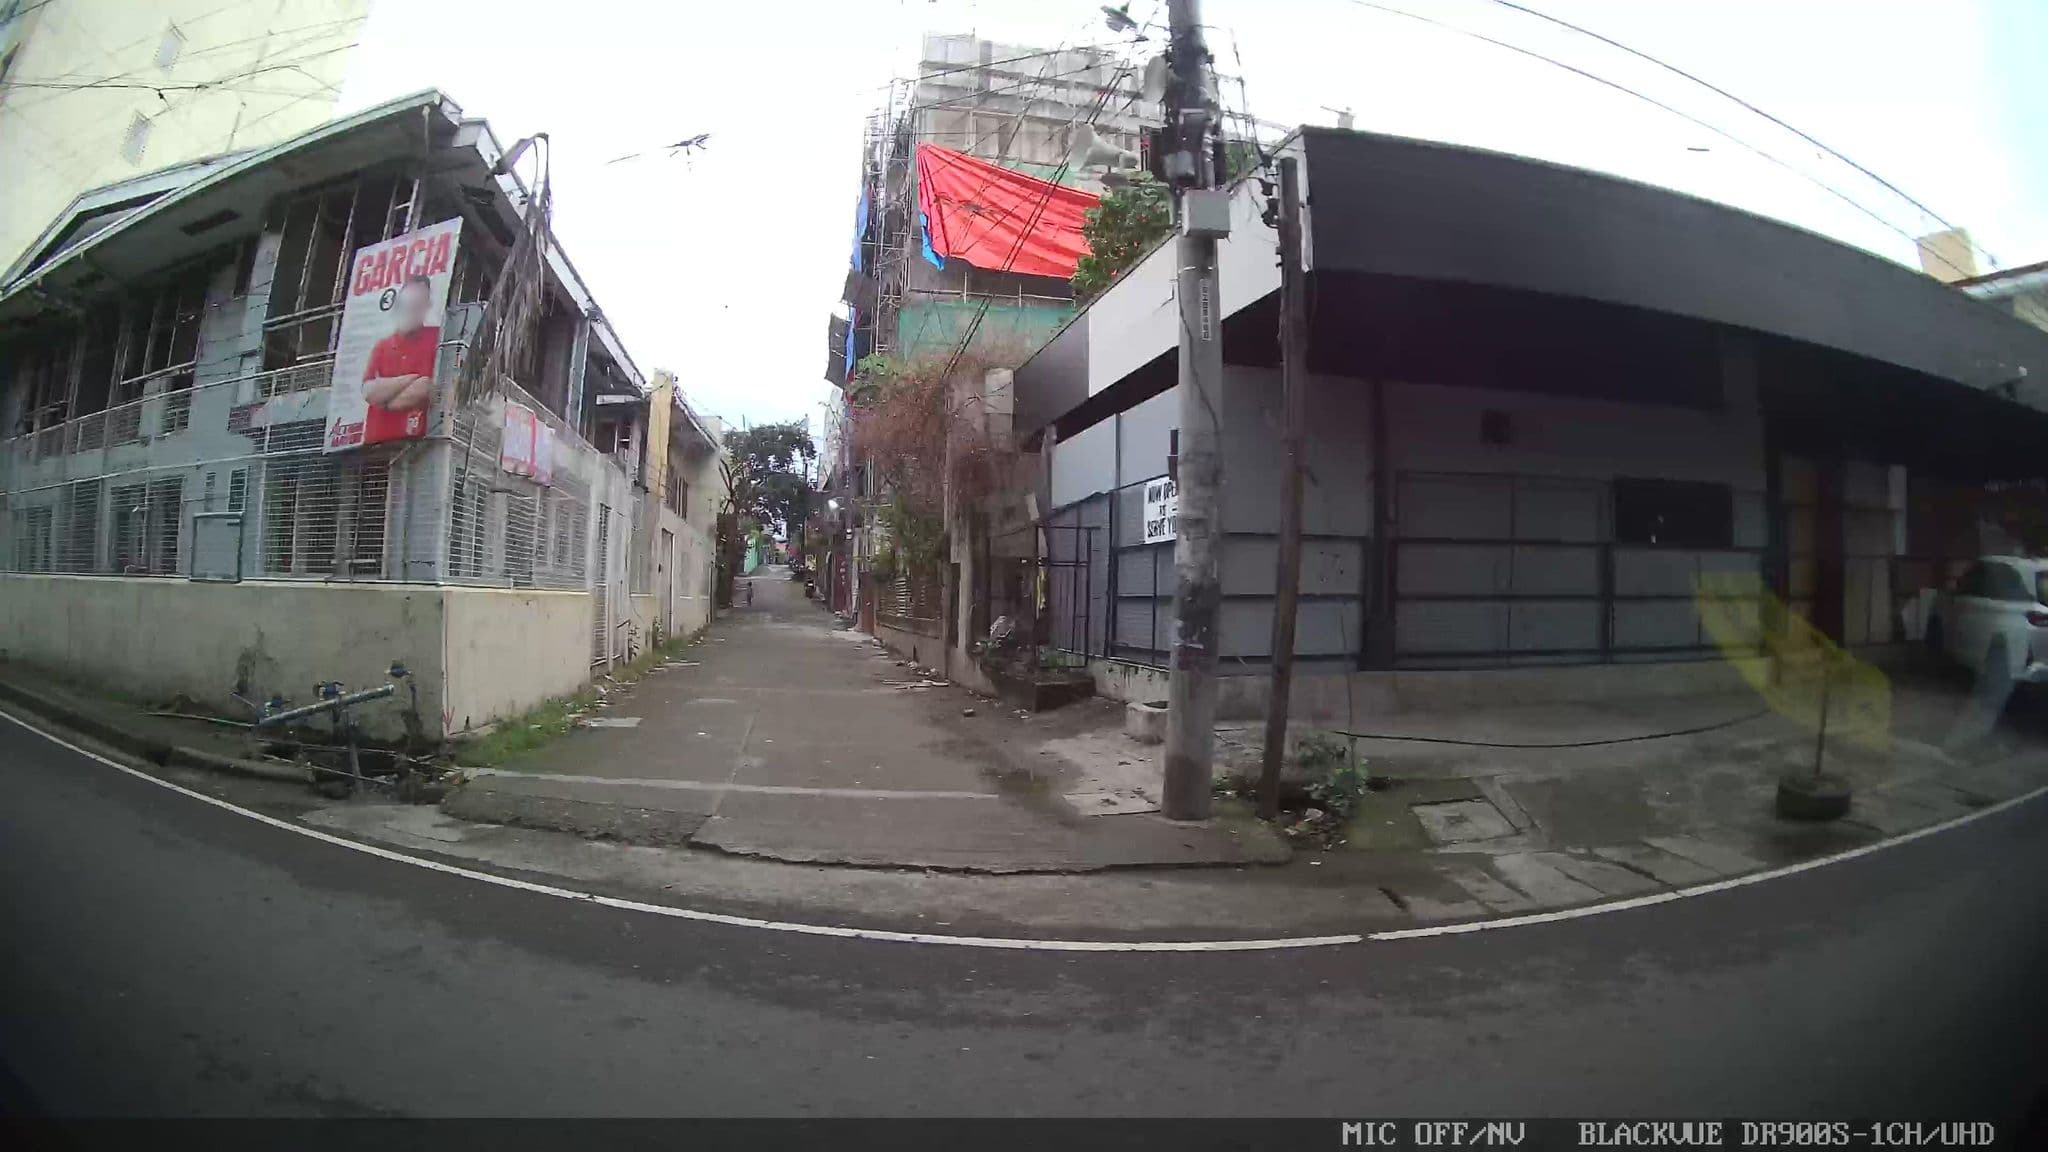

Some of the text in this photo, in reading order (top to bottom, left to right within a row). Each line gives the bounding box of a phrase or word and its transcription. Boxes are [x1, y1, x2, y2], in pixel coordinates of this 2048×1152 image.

[353, 231, 452, 297] GARCIA
[1148, 481, 1177, 504] NOW OPE
[1167, 515, 1177, 534] YO
